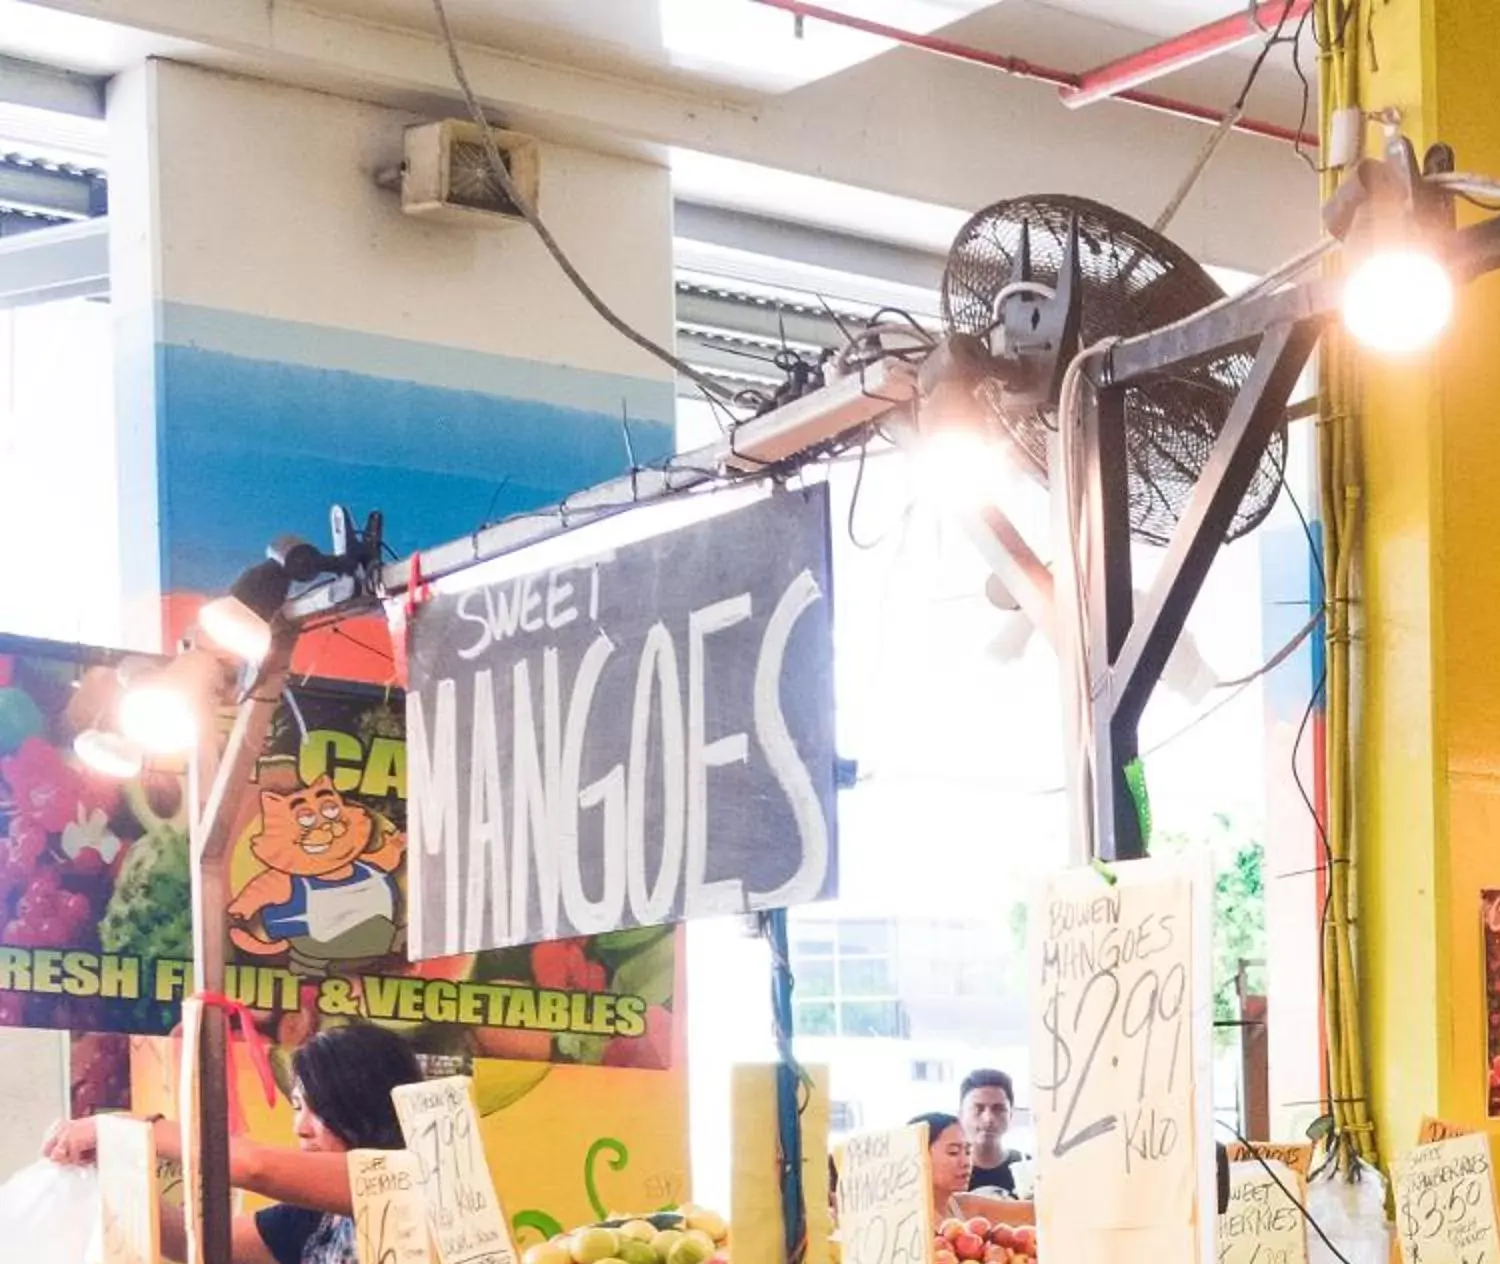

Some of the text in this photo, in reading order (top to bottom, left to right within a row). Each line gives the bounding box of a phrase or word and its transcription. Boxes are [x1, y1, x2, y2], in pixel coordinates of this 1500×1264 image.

[456, 564, 603, 661] SWEET
[407, 571, 831, 957] MANGOES
[1042, 914, 1176, 986] MANGOES
[1050, 890, 1121, 938] BOWEN
[0, 947, 140, 999] RESH
[319, 981, 362, 1016] &
[369, 976, 647, 1037] VEGETABLES
[1036, 962, 1186, 1158] $2.99
[1219, 1205, 1300, 1240] HERRIES
[1229, 1181, 1275, 1204] WEET
[1401, 1179, 1482, 1241] $3.50
